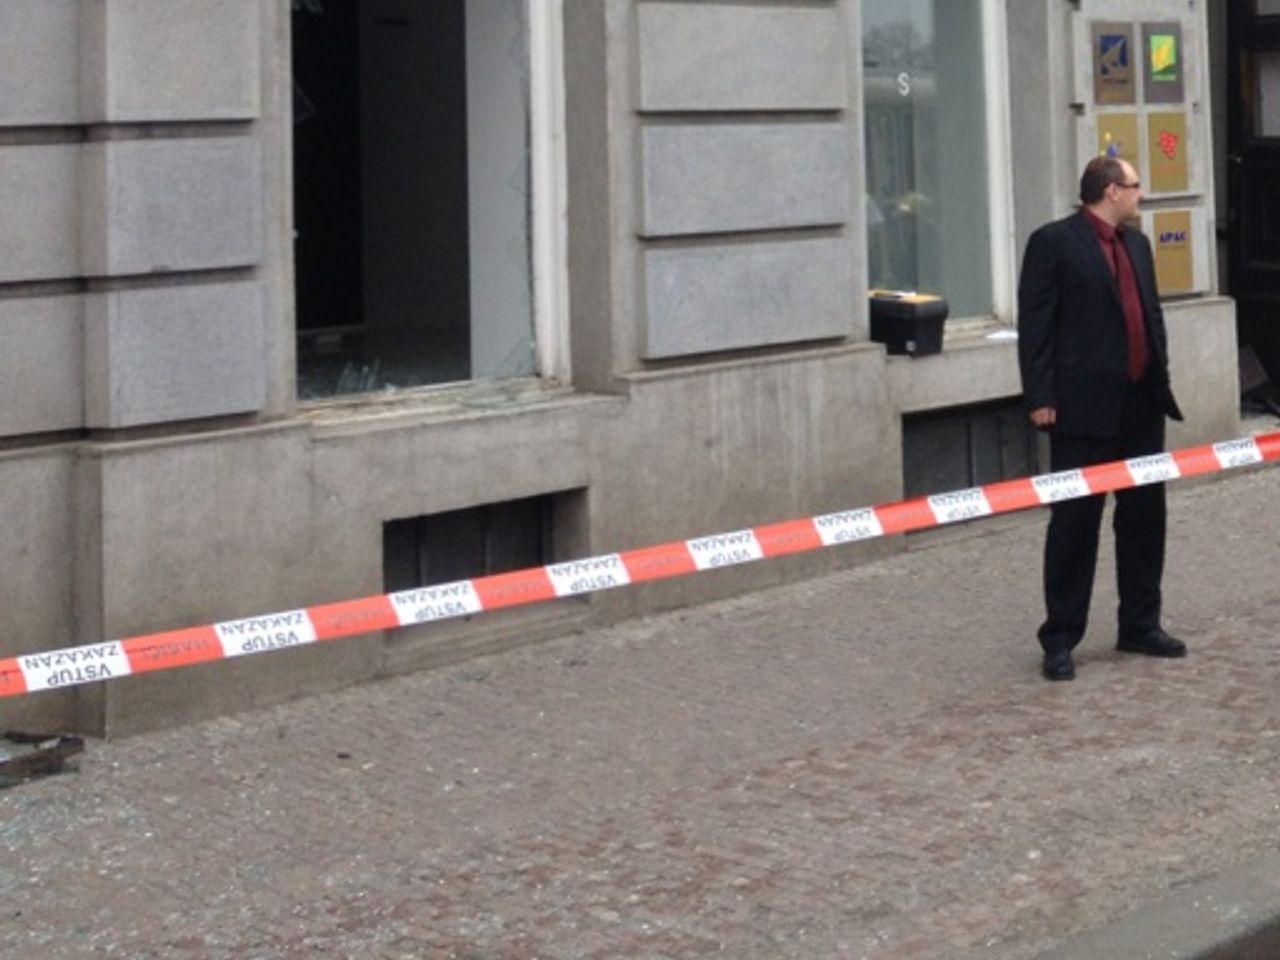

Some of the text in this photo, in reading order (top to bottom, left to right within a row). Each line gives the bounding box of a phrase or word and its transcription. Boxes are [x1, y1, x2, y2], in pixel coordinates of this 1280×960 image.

[707, 547, 752, 566] VSTUP
[568, 572, 617, 593] VSTUP
[413, 599, 466, 621] VSTUP
[240, 629, 300, 652] VSTUP
[44, 661, 112, 687] VSTUP
